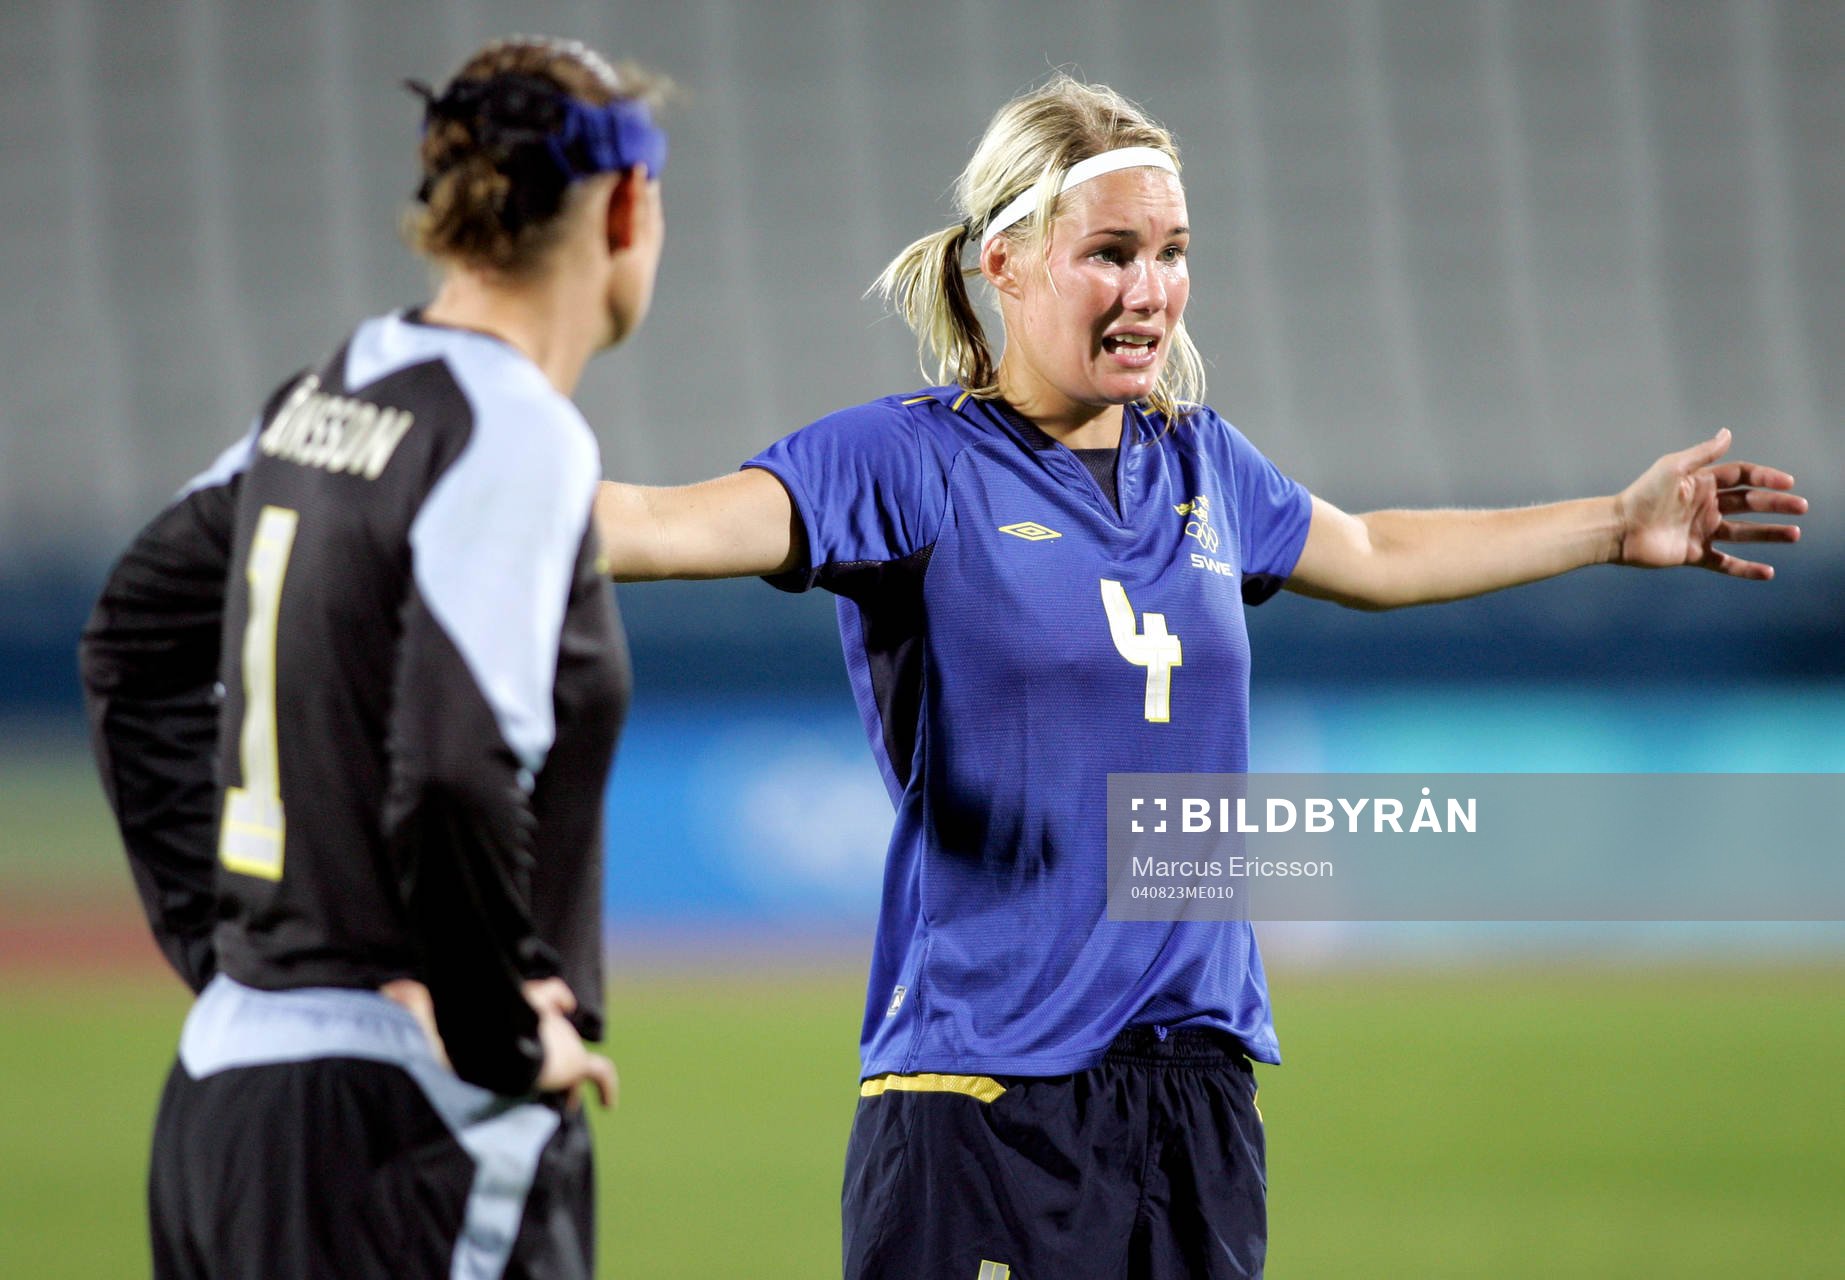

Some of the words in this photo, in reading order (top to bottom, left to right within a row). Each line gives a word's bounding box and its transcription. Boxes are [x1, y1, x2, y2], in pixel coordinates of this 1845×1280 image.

[1190, 553, 1234, 577] SWE
[217, 504, 299, 882] 1
[1100, 578, 1182, 723] 4
